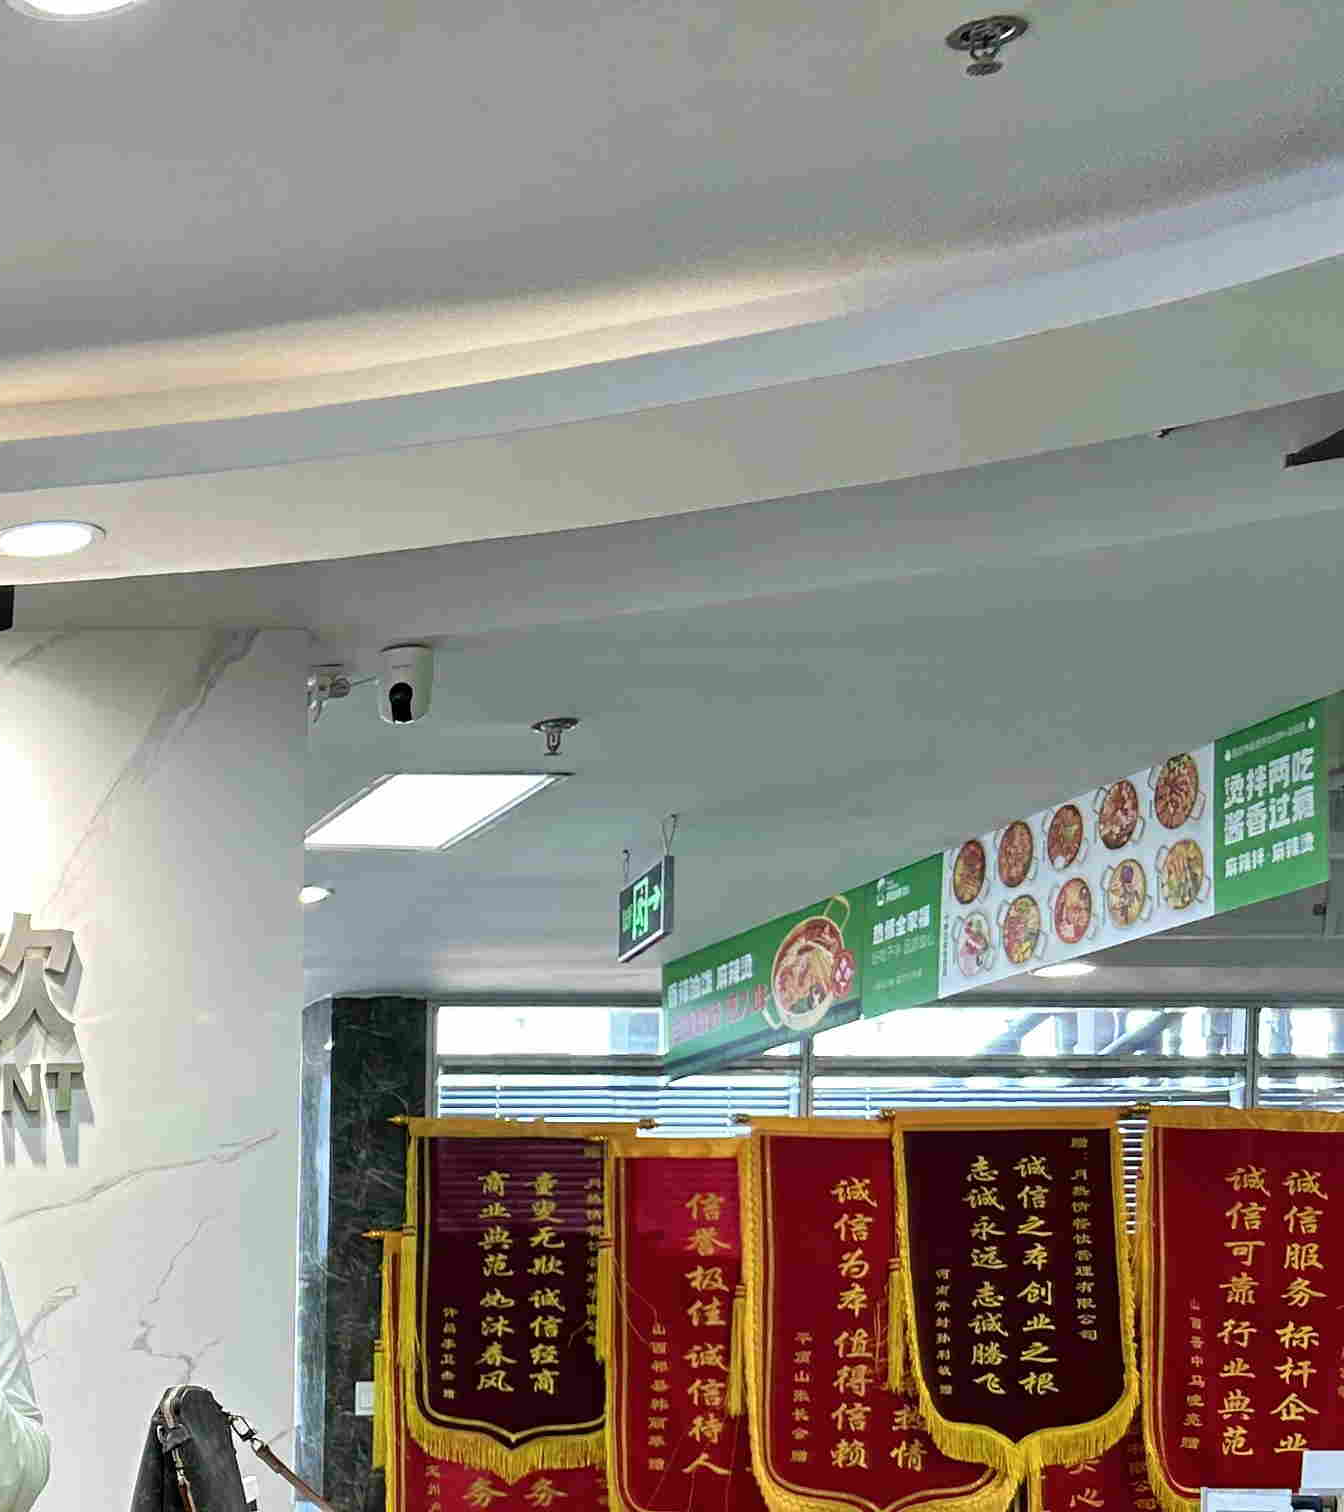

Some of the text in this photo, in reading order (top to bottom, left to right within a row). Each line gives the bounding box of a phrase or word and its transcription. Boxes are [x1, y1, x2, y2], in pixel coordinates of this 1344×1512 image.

[830, 1177, 878, 1470] 诚信为本值得信赖
[1013, 1155, 1061, 1395] 诚信之本创业之根
[1217, 1164, 1271, 1456] 诚信可靠行业典范
[1270, 1168, 1328, 1454] 诚信服务标杆企业
